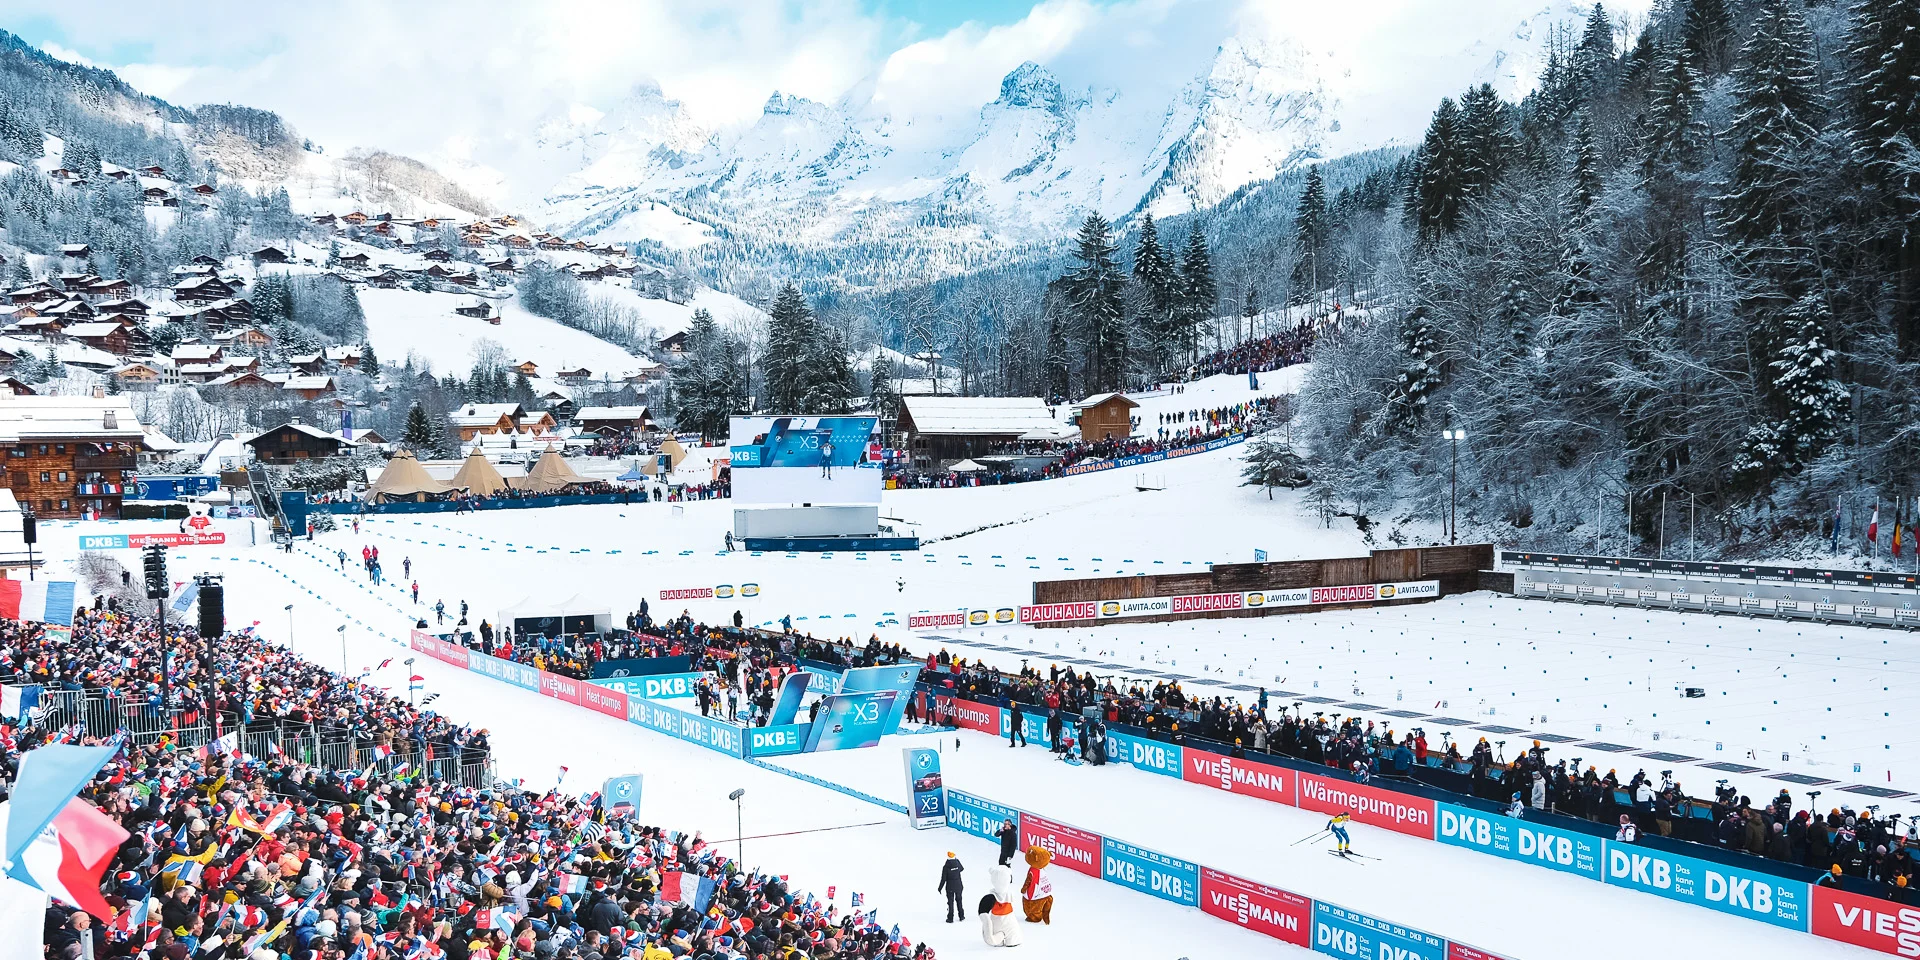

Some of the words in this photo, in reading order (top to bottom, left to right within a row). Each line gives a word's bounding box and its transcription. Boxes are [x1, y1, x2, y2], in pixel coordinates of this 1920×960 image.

[799, 435, 819, 449] X3
[1142, 453, 1164, 463] Türen
[1207, 440, 1227, 449] Garage
[1228, 435, 1244, 443] Doors
[85, 536, 114, 548] DKB
[661, 588, 713, 600] BAUHAUS
[1266, 593, 1308, 603] LAVITA.COM
[1312, 586, 1375, 603] BAUHAUS
[1397, 585, 1436, 595] LAVITA.COM
[1123, 602, 1168, 612] LAVITA.COM
[1173, 594, 1241, 612] BAUHAUS
[909, 613, 964, 627] BAUHAUS
[1020, 603, 1096, 622] BAUHAUS
[541, 675, 576, 698] VIESSMANN
[645, 678, 687, 696] DKB
[586, 687, 600, 704] Heat
[601, 695, 622, 712] pumps
[629, 701, 646, 723] DKB
[653, 708, 672, 731] DKB
[853, 702, 879, 722] X3
[936, 699, 957, 717] Heat
[958, 706, 990, 728] pumps
[682, 717, 702, 740] DKB
[1003, 713, 1030, 738] DB
[710, 725, 732, 750] DKB
[753, 731, 785, 747] DKB
[1133, 742, 1166, 769] DKB
[1192, 757, 1283, 792] VIESSMANN
[921, 796, 939, 811] X3
[1302, 778, 1428, 825] Wärmepumpen
[949, 806, 972, 829] DKB
[982, 816, 1004, 838] DK
[1441, 809, 1492, 846] DKB
[1494, 822, 1507, 833] Das
[1494, 831, 1510, 842] kann
[1027, 832, 1092, 865] VIESSMANN
[1494, 841, 1510, 851] Bank
[1518, 827, 1574, 866] DKB
[1577, 841, 1591, 851] Das
[1576, 851, 1594, 862] kann
[1106, 856, 1136, 883] DKB
[1576, 860, 1595, 872] Bank
[1610, 848, 1672, 890] DKB
[1675, 863, 1691, 875] Das
[1151, 870, 1182, 898] DKB
[1675, 874, 1694, 886] kann
[1675, 884, 1695, 897] Bank
[1704, 869, 1773, 914] DKB
[1777, 886, 1795, 899] Das
[1210, 890, 1298, 932] VIESSMANN
[1318, 903, 1330, 913] DKB
[1333, 908, 1344, 917] DKB
[1777, 898, 1798, 911] kann
[1347, 912, 1359, 921] DKB
[1362, 917, 1374, 927] DKB
[1777, 907, 1799, 922] Bank
[1378, 921, 1390, 931] DKB
[1393, 926, 1406, 936] DKB
[1833, 902, 1920, 957] VIESS
[1317, 922, 1358, 955] DKB
[1409, 931, 1422, 941] DKB
[1425, 936, 1438, 946] DKB
